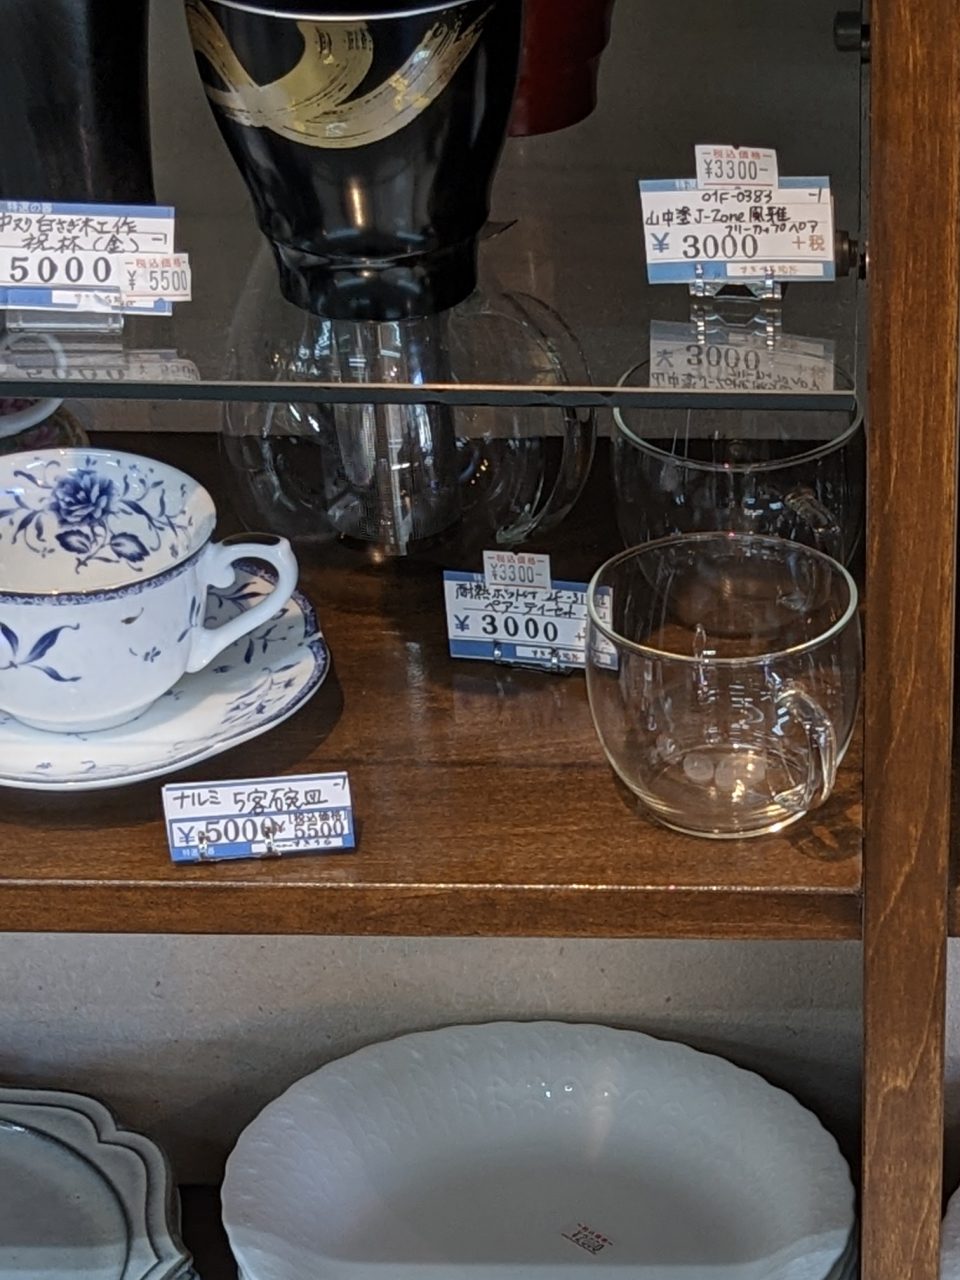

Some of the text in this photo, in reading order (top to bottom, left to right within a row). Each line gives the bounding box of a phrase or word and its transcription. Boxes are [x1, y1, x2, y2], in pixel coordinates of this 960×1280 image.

[682, 235, 758, 259] 3000
[10, 256, 112, 282] 5000
[482, 614, 558, 643] 3000
